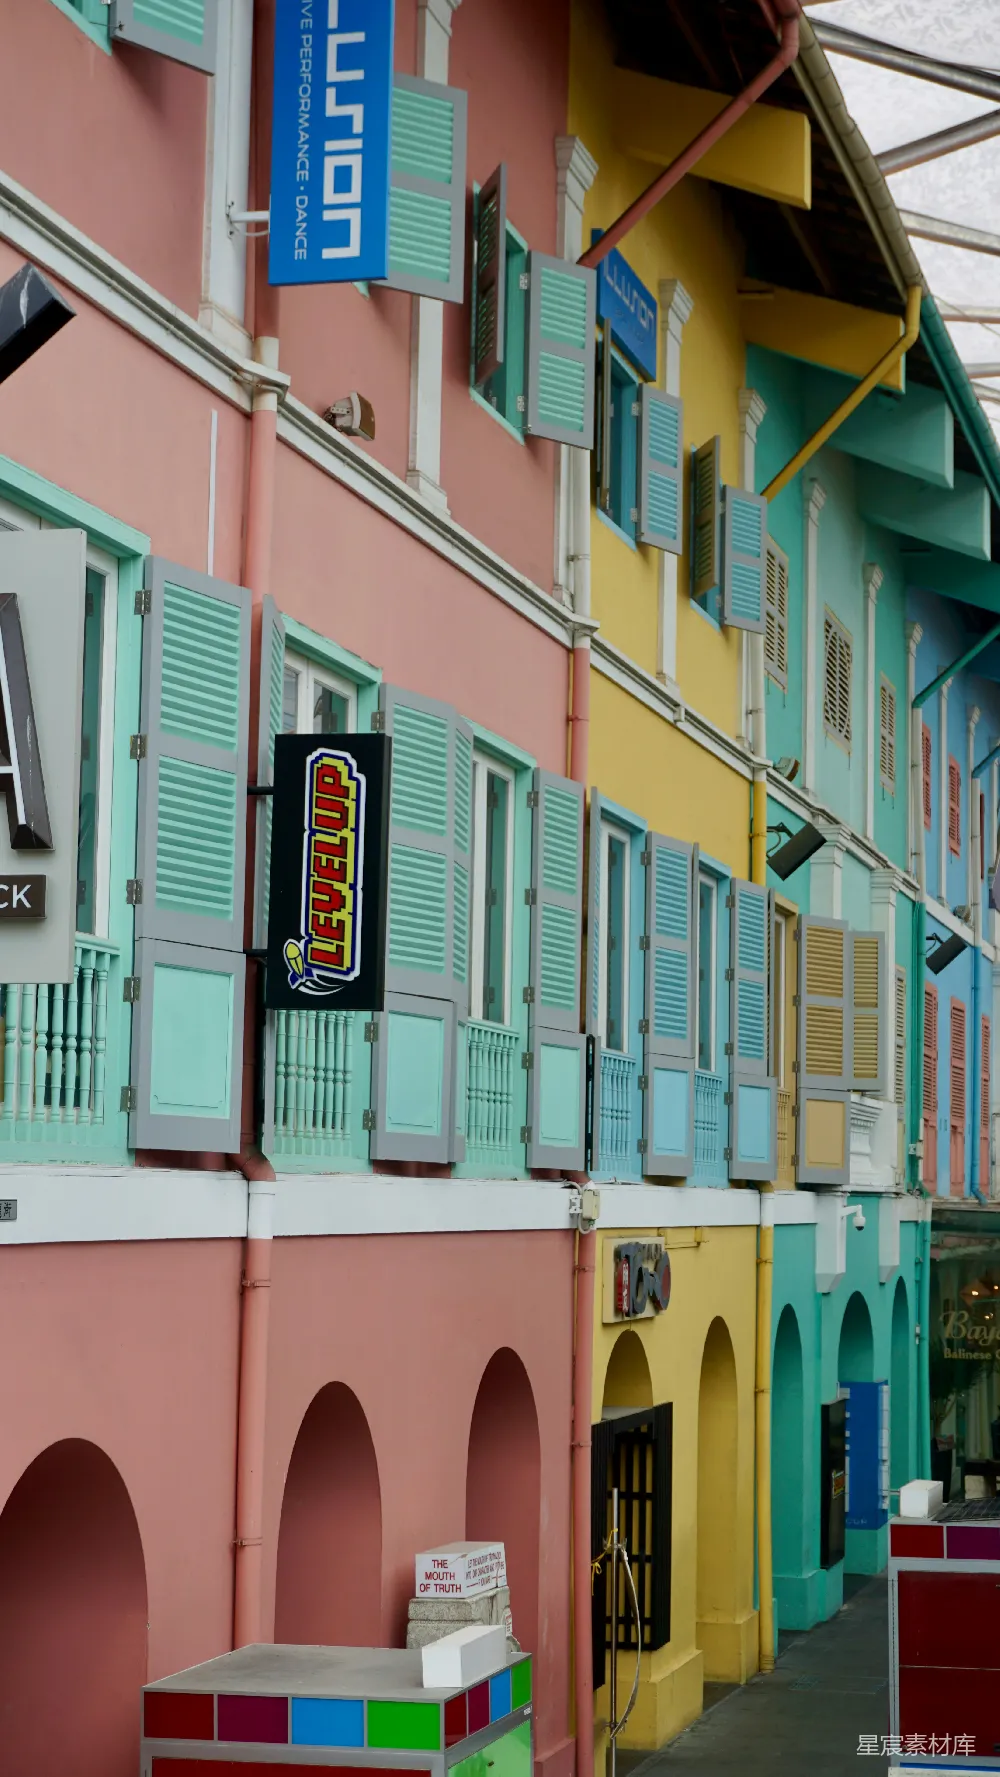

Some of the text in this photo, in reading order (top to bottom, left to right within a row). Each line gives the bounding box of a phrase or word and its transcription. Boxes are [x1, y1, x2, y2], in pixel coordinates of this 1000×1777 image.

[296, 33, 313, 182] PERFORMANCE
[294, 195, 309, 260] DANCE
[944, 1347, 992, 1360] Balinese
[431, 1559, 449, 1569] THE
[424, 1571, 456, 1581] MOUTH
[419, 1582, 462, 1594] OF TRUTH
